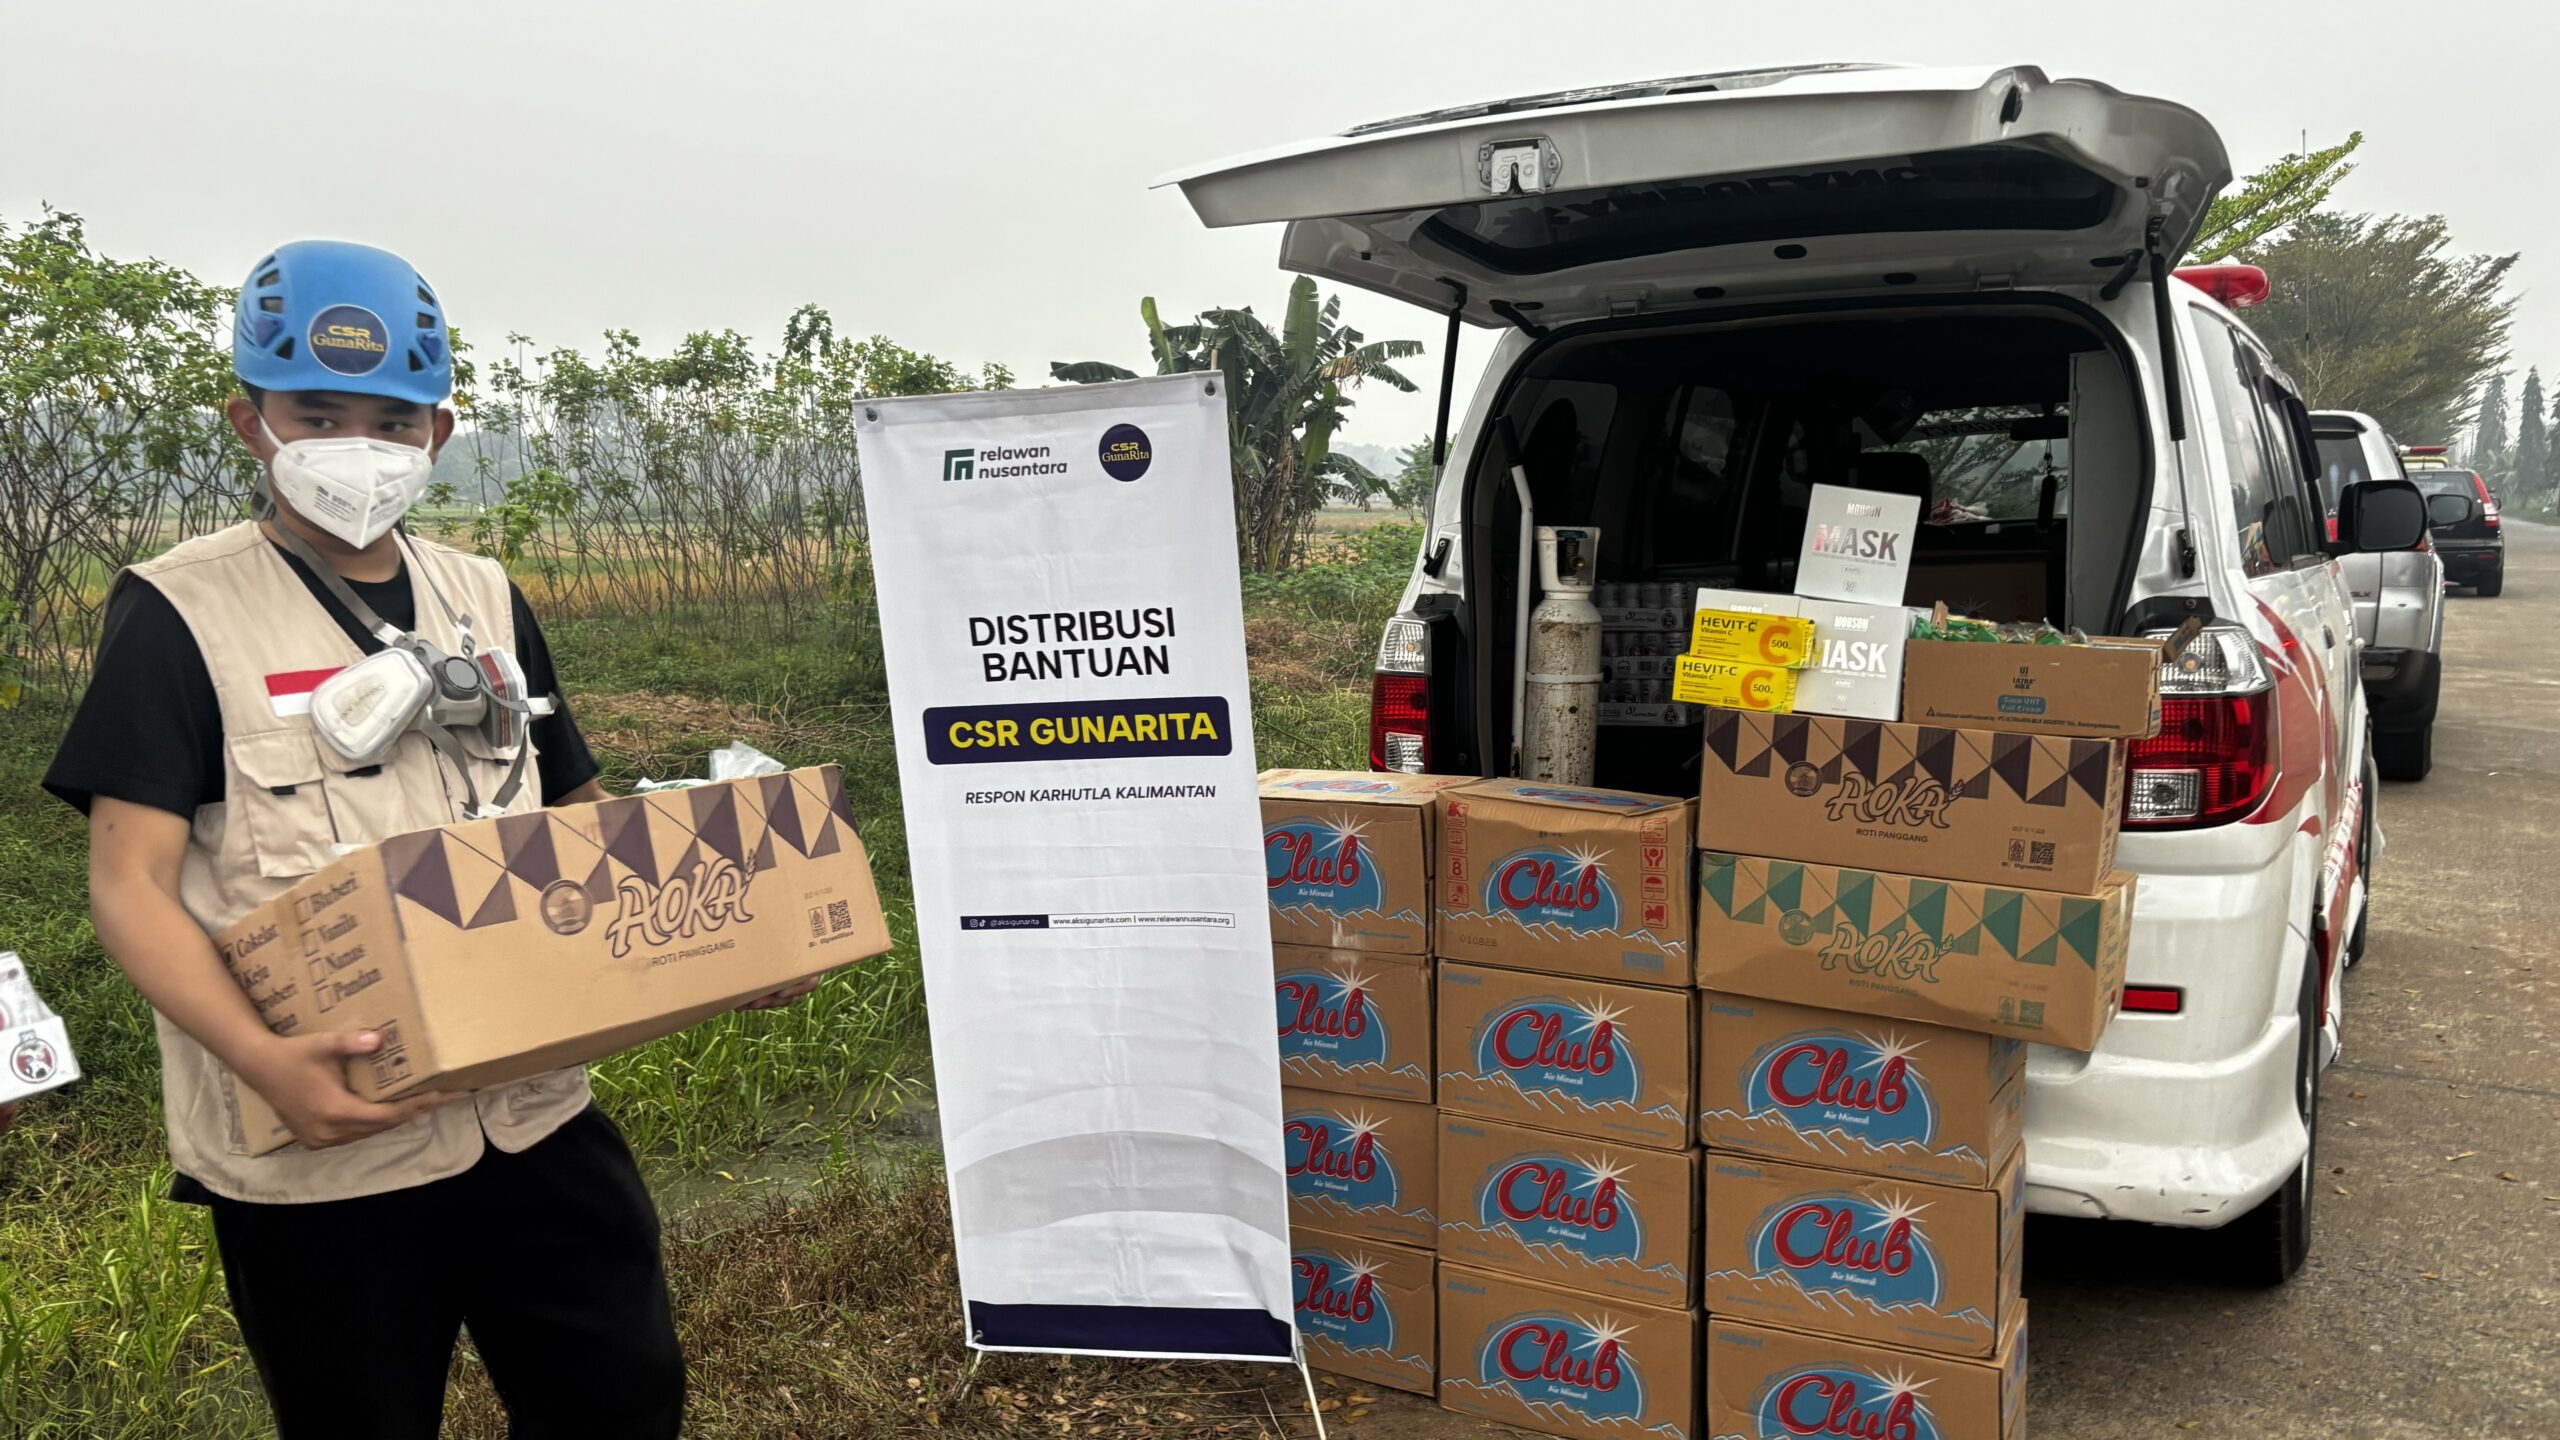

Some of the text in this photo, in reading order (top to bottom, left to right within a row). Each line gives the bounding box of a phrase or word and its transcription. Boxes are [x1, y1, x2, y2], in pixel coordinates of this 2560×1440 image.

[327, 325, 370, 338] CSR
[312, 335, 385, 353] GunaRita
[980, 445, 1050, 462] relawan
[1102, 449, 1150, 462] GunaRita
[1111, 442, 1139, 452] CSR
[979, 460, 1068, 480] nusantara
[1814, 524, 1900, 561] MASK
[968, 607, 1176, 646] DISTRIBUSI
[1701, 616, 1758, 632] HEVIT-C
[1701, 627, 1726, 635] Vitamin
[1771, 640, 1789, 649] 500
[982, 645, 1170, 682] BANTUAN
[1682, 661, 1739, 677] HEVIT-C
[1682, 672, 1707, 680] Vitamin
[1753, 684, 1770, 693] 500
[948, 712, 1218, 749] CSR GUNARITA
[965, 785, 1216, 804] RESPON KARHUTLA KALIMANTAN
[1825, 771, 1951, 829] AOKA
[1856, 828, 1928, 843] ROTI PANGGANG
[1298, 888, 1334, 898] Air Mineral
[1498, 858, 1600, 911] Club
[605, 857, 754, 959] AOKA
[1053, 916, 1132, 926] www.aksigunarita.com
[1137, 915, 1230, 926] www.relawannusantara.org
[651, 939, 736, 968] ROTI PANGGANG
[1819, 921, 1941, 984] AOKA
[1849, 978, 1919, 997] ROTI PANGGANG
[1303, 1038, 1339, 1050] Air Mineral
[1493, 1008, 1615, 1076] Club
[1543, 1072, 1584, 1086] Air Mineral
[1767, 1044, 1906, 1114] Club
[1824, 1110, 1870, 1125] Air Mineral
[1313, 1179, 1349, 1192] Air Mineral
[1497, 1162, 1618, 1232] Club
[1547, 1226, 1587, 1241] Air Mineral
[1772, 1204, 1912, 1277] Club
[1830, 1271, 1876, 1286] Air Mineral
[1497, 1323, 1620, 1392] Club
[1548, 1385, 1588, 1400] Air Mineral
[1776, 1374, 1917, 1440] Club
